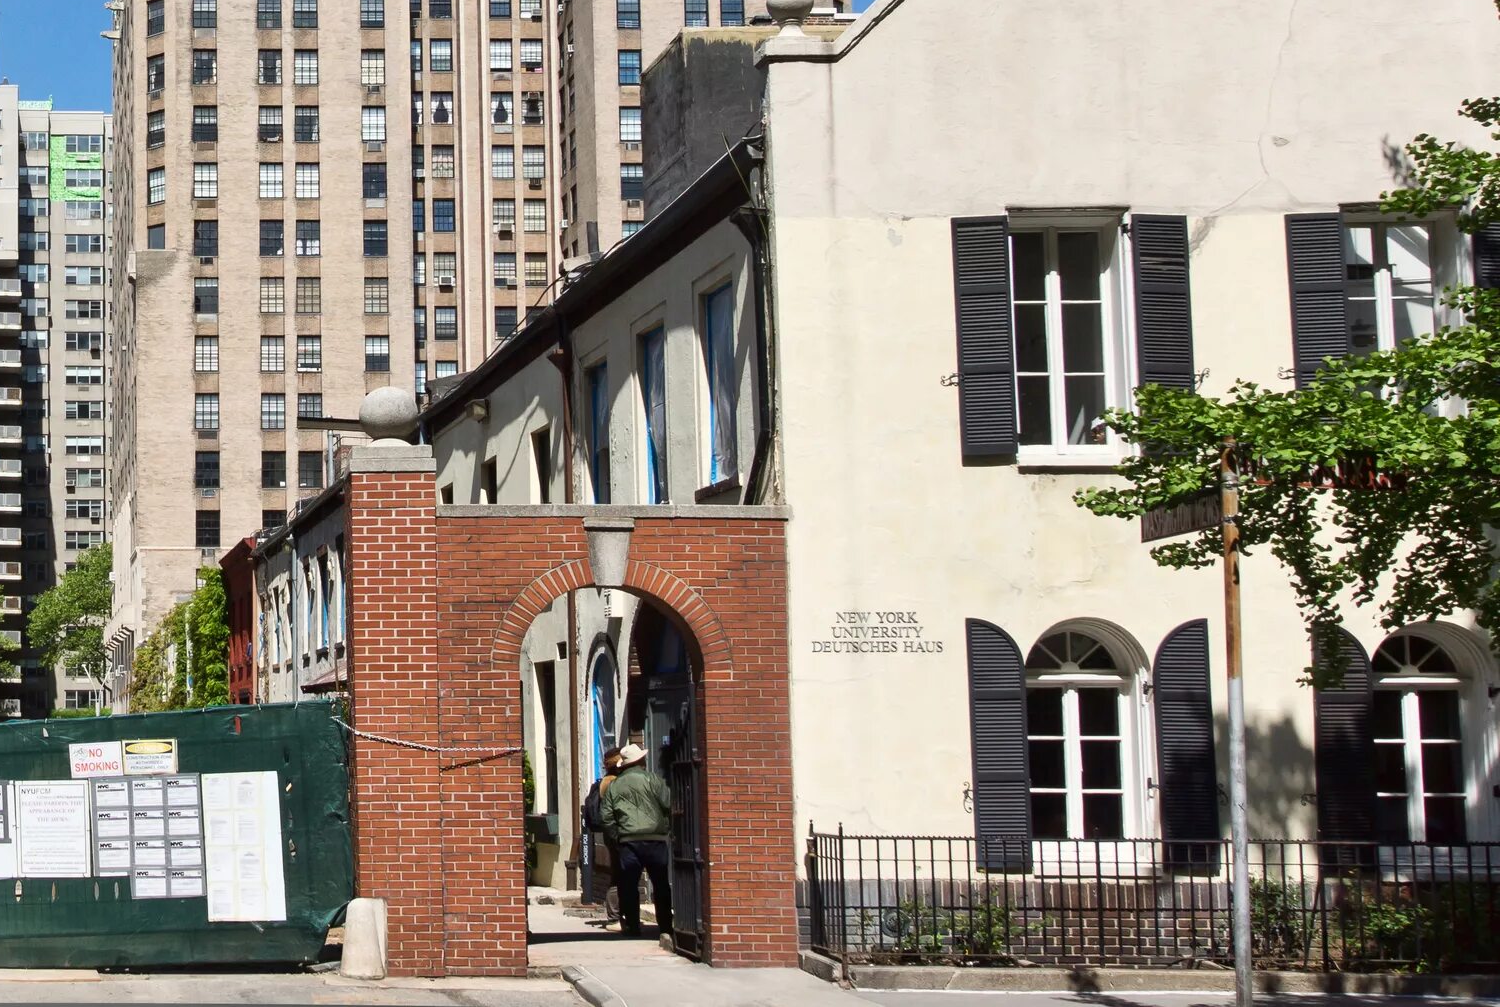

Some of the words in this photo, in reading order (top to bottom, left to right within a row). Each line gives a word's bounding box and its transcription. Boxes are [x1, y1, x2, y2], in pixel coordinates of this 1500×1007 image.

[836, 612, 871, 624] NEW
[875, 612, 918, 624] YORK
[831, 626, 924, 639] UNIVERSITY
[811, 641, 898, 653] DEUTSCHES
[903, 641, 944, 653] HAUS
[88, 748, 103, 758] NO
[74, 761, 119, 772] SMOKING
